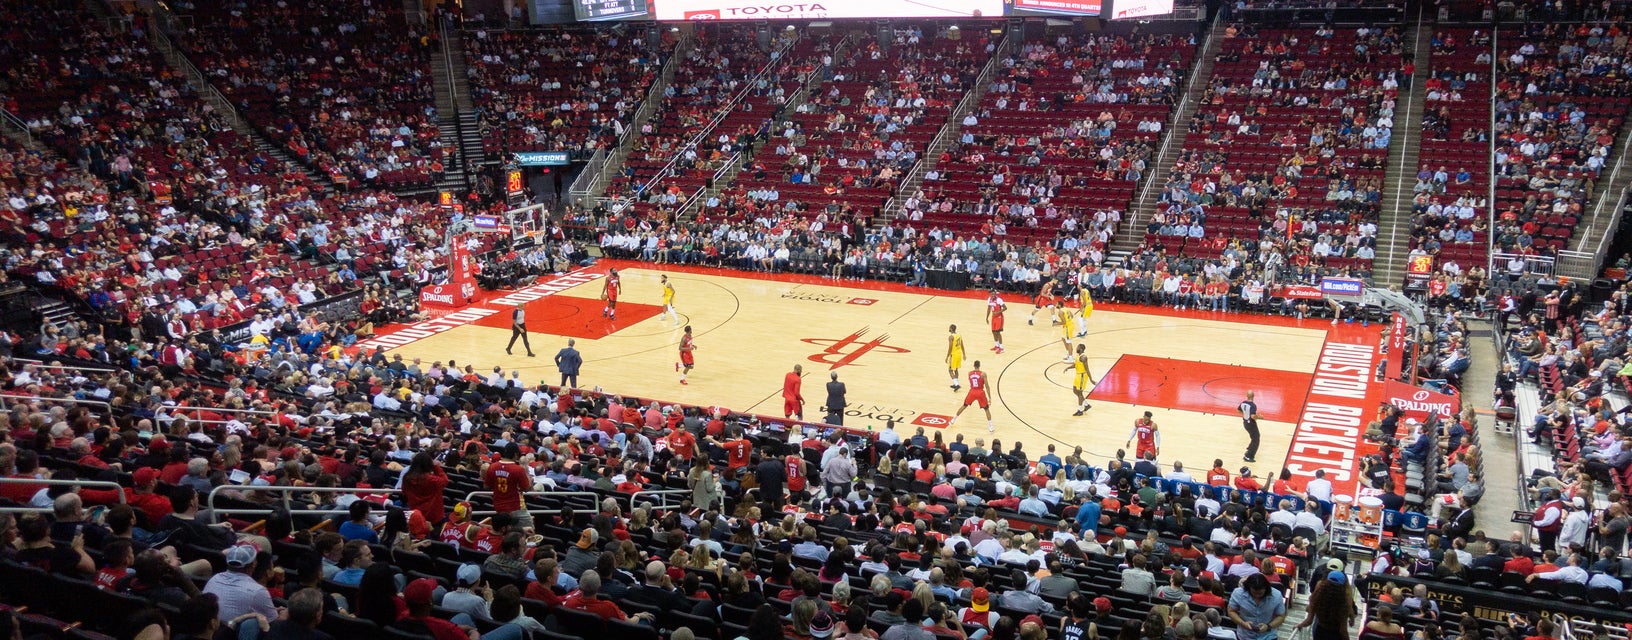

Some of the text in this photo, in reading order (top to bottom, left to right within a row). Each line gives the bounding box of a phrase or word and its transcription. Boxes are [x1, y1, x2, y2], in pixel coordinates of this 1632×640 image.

[726, 3, 827, 15] TOYOTA
[1128, 5, 1148, 14] TOYOTA
[510, 180, 521, 190] 20
[489, 273, 605, 306] ROCKETS
[422, 292, 454, 304] SPALDING
[355, 307, 500, 351] HOUSTON
[1394, 317, 1403, 348] NBA TV
[1311, 342, 1375, 399] HOUSTON
[1287, 402, 1363, 481] ROCKETS
[497, 477, 508, 493] 13
[443, 528, 463, 539] HARDEN
[1065, 625, 1084, 636] HARDEN
